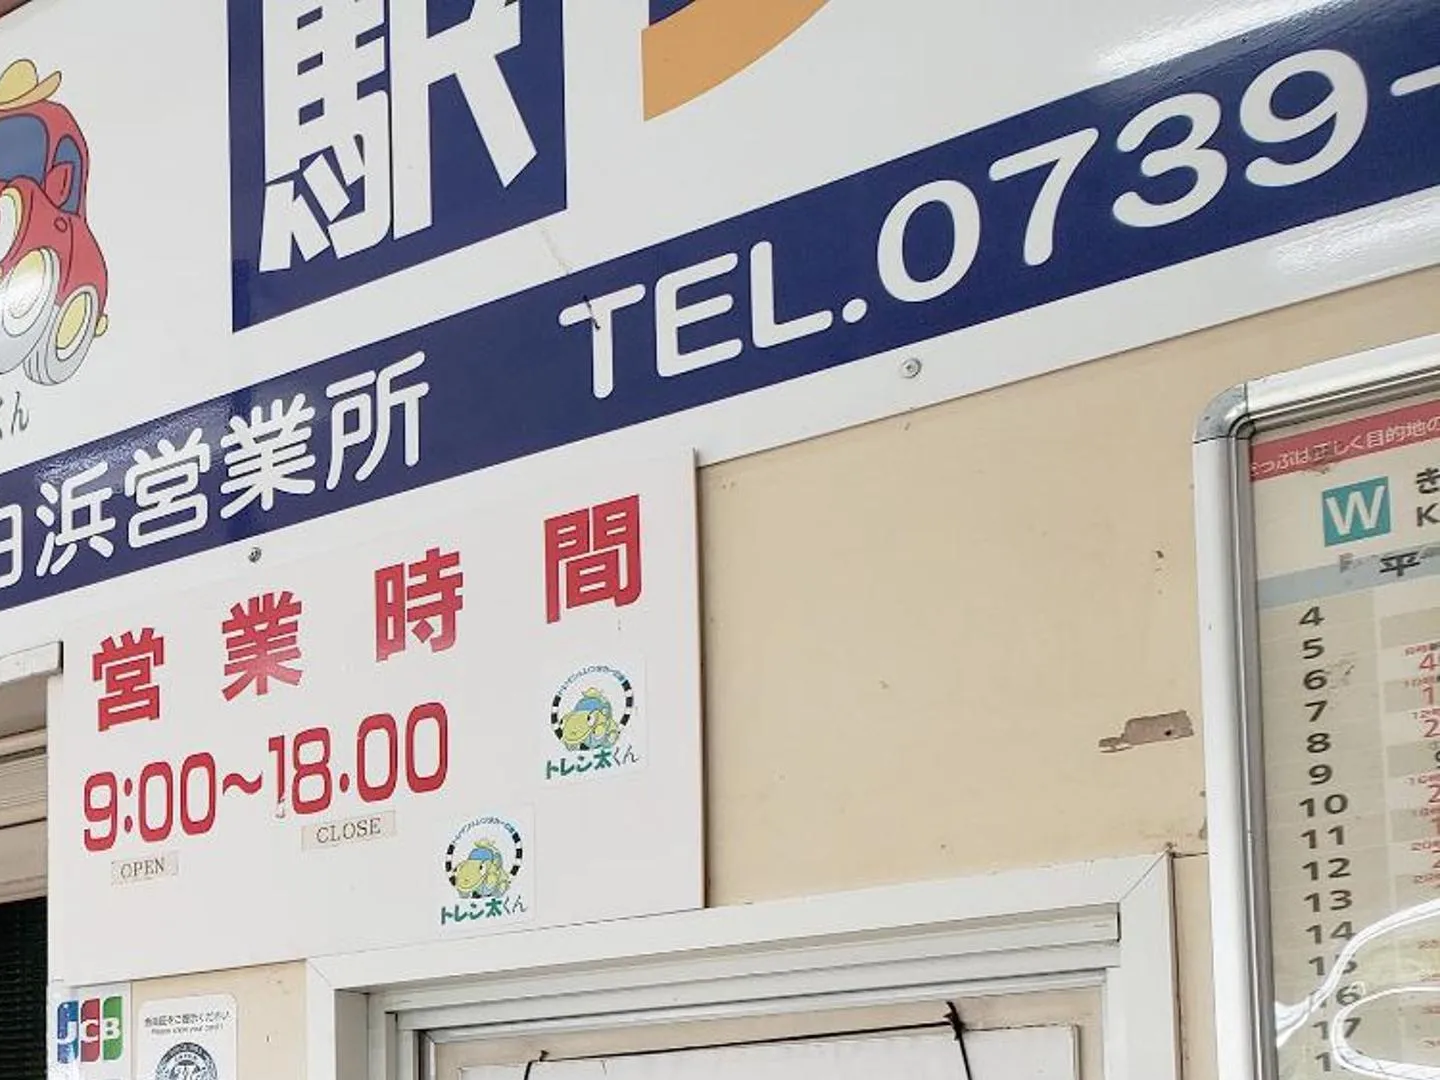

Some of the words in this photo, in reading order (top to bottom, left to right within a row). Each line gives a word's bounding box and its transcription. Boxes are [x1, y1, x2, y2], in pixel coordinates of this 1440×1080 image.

[260, 0, 538, 273] 駅
[1326, 485, 1386, 536] W
[92, 494, 642, 732] 営業時間
[1299, 606, 1325, 626] 4
[1302, 638, 1324, 659] 5
[1304, 670, 1327, 690] 6
[1305, 701, 1327, 722] 7
[1307, 733, 1331, 753] 8
[546, 744, 640, 780] トレン太くん
[1308, 764, 1332, 785] 9
[1299, 794, 1348, 817] 10
[315, 816, 382, 845] CLOSE
[1301, 825, 1344, 849] 11
[119, 855, 166, 881] OPEN
[1302, 857, 1351, 880] 12
[441, 895, 528, 925] トレン太くん
[1303, 889, 1353, 912] 13
[1306, 921, 1355, 945] 14
